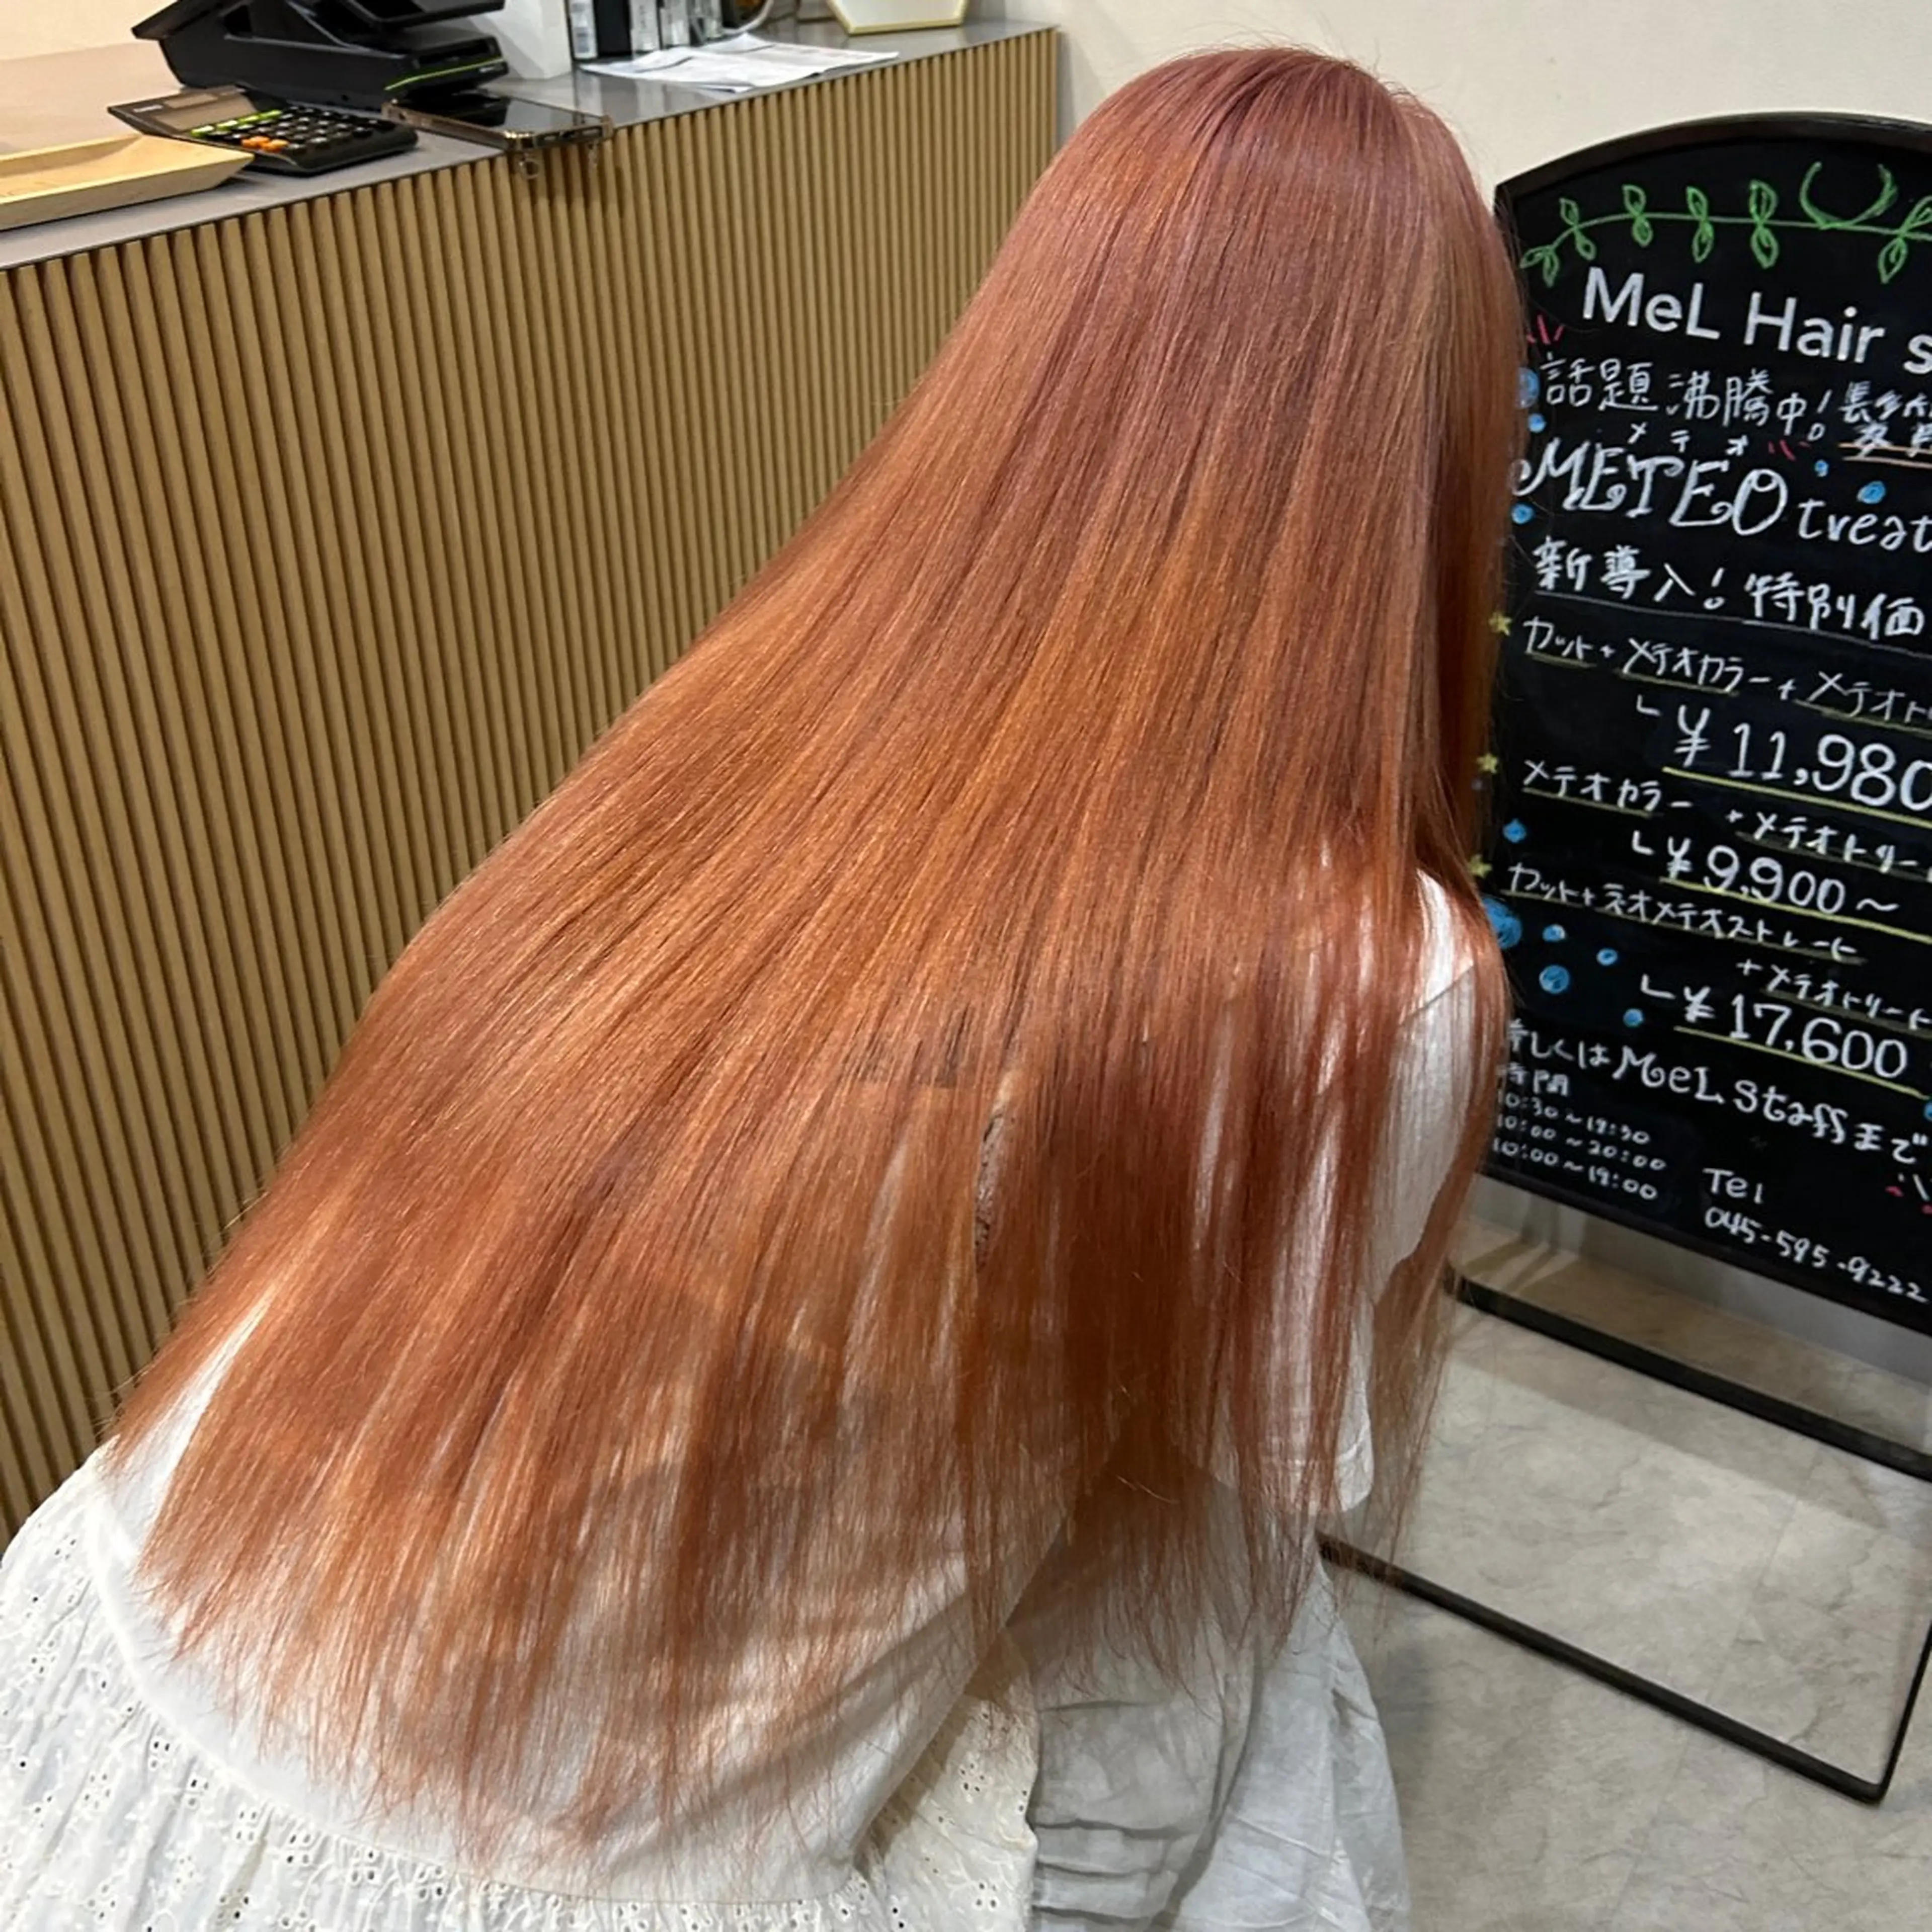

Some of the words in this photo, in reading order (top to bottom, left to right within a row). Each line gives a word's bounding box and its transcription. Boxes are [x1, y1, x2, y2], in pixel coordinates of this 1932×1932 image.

[1582, 267, 1721, 341] MeL
[1744, 291, 1885, 364] Hair
[1508, 437, 1788, 536] METEO
[1703, 1167, 1764, 1204] Tel
